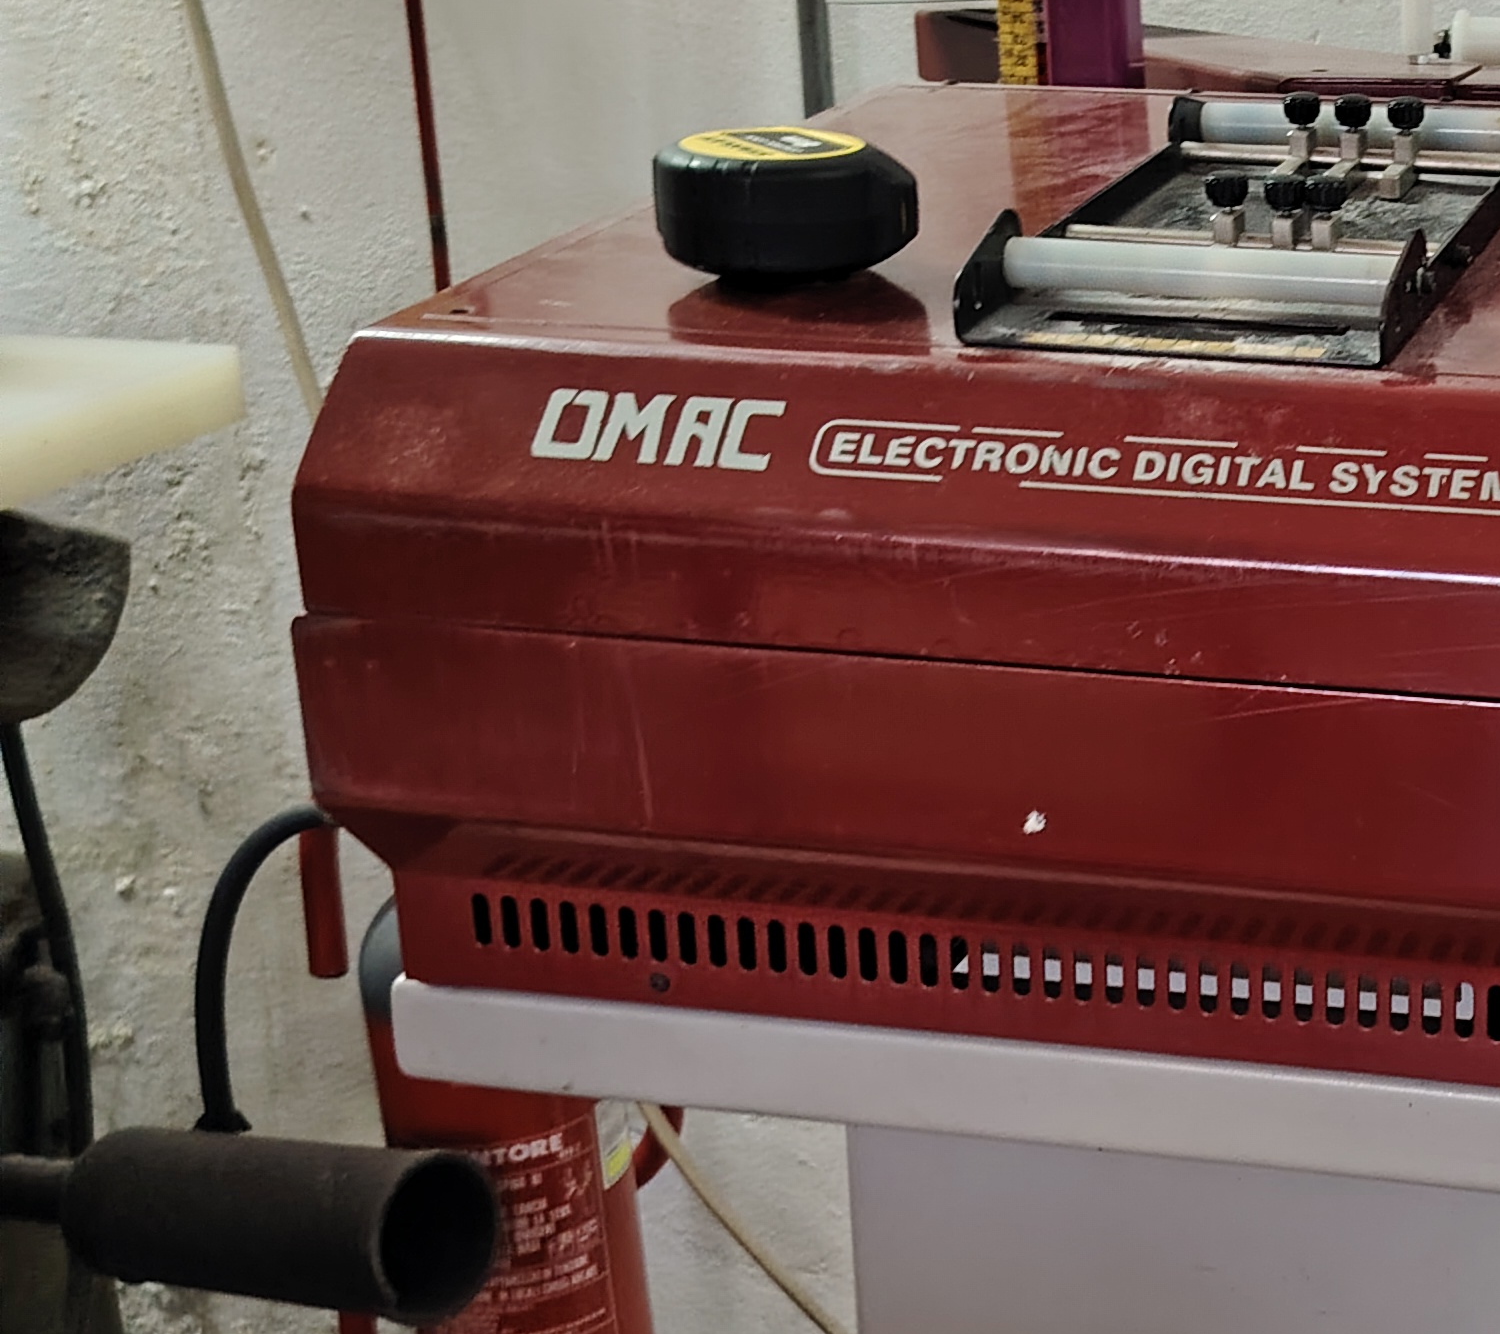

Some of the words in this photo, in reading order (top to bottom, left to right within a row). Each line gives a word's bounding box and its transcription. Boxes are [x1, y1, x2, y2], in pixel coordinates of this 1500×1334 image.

[530, 388, 787, 472] OMAC
[828, 431, 1120, 481] ELECTRONIC
[1133, 449, 1315, 492] DIGITAL
